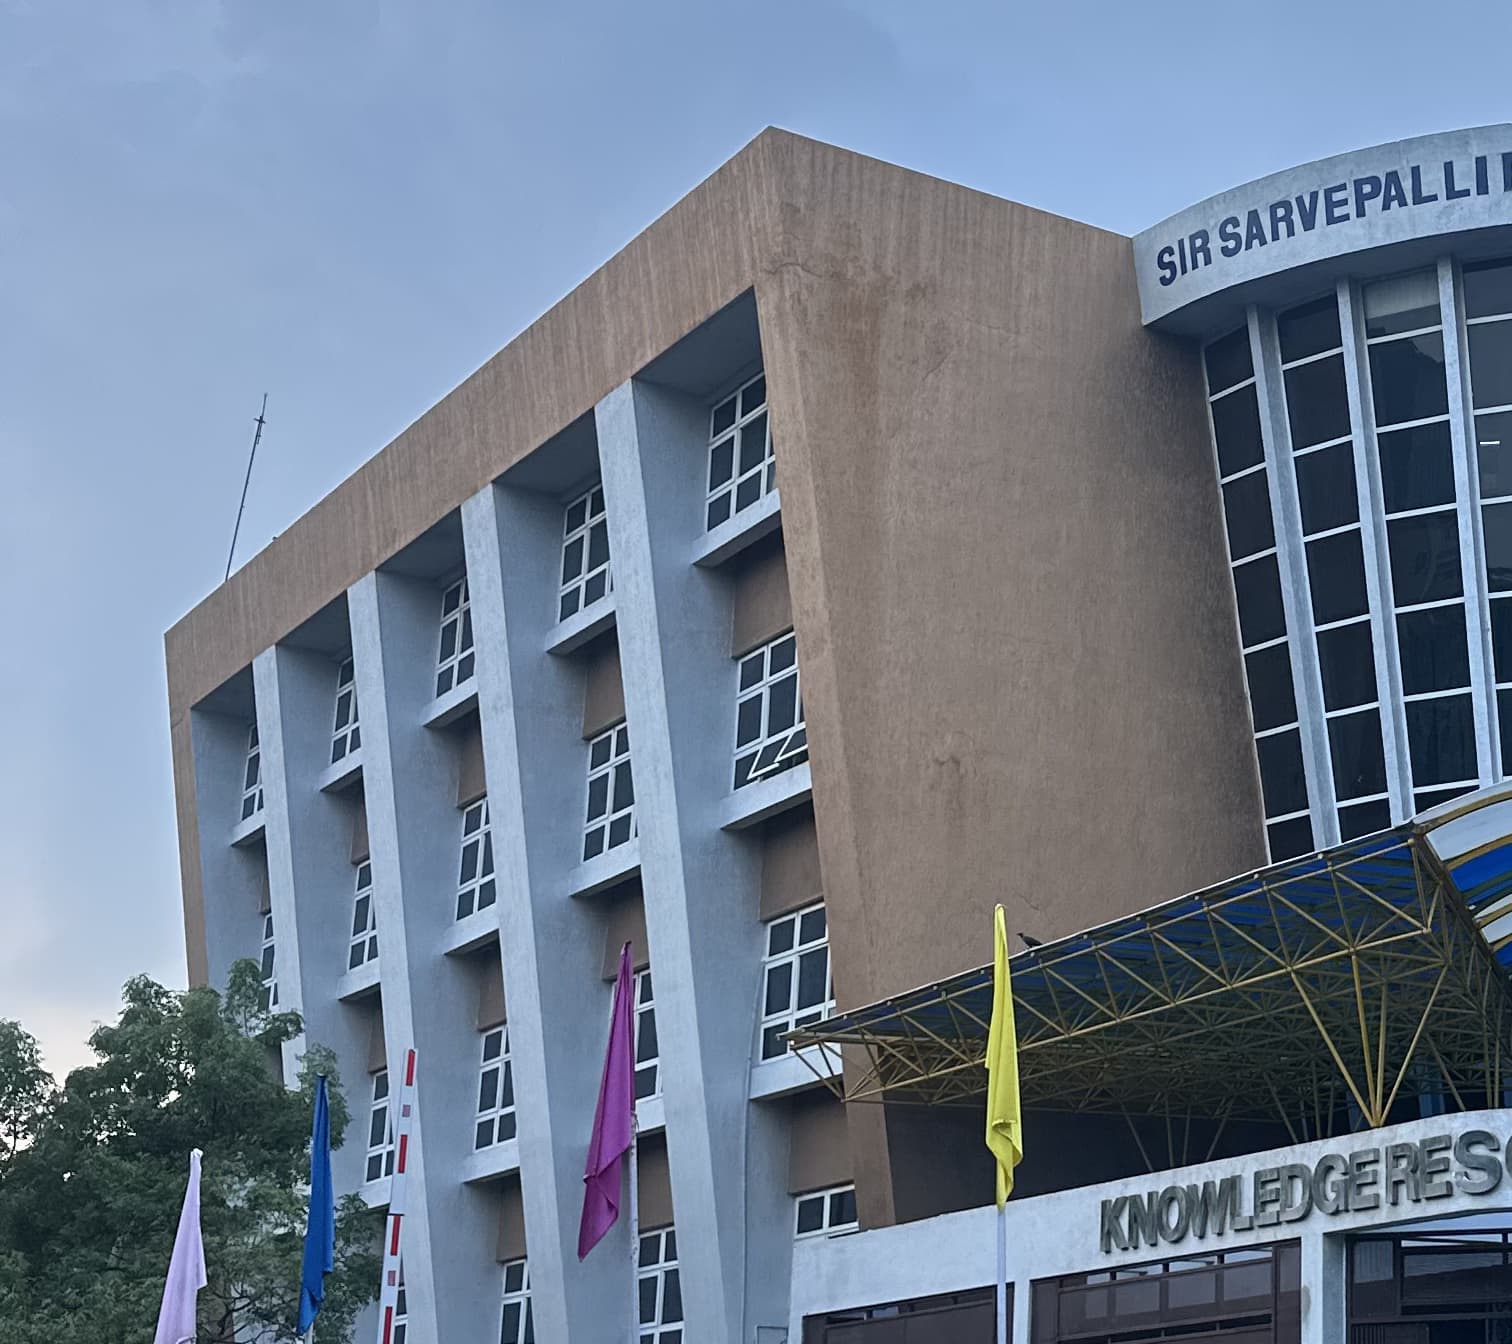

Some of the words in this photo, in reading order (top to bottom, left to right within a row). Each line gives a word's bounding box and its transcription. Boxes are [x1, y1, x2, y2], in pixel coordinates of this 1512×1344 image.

[1156, 228, 1212, 287] SIR
[1218, 155, 1490, 258] SARVEPALLI
[1100, 1147, 1380, 1254] KNOWLEDGE
